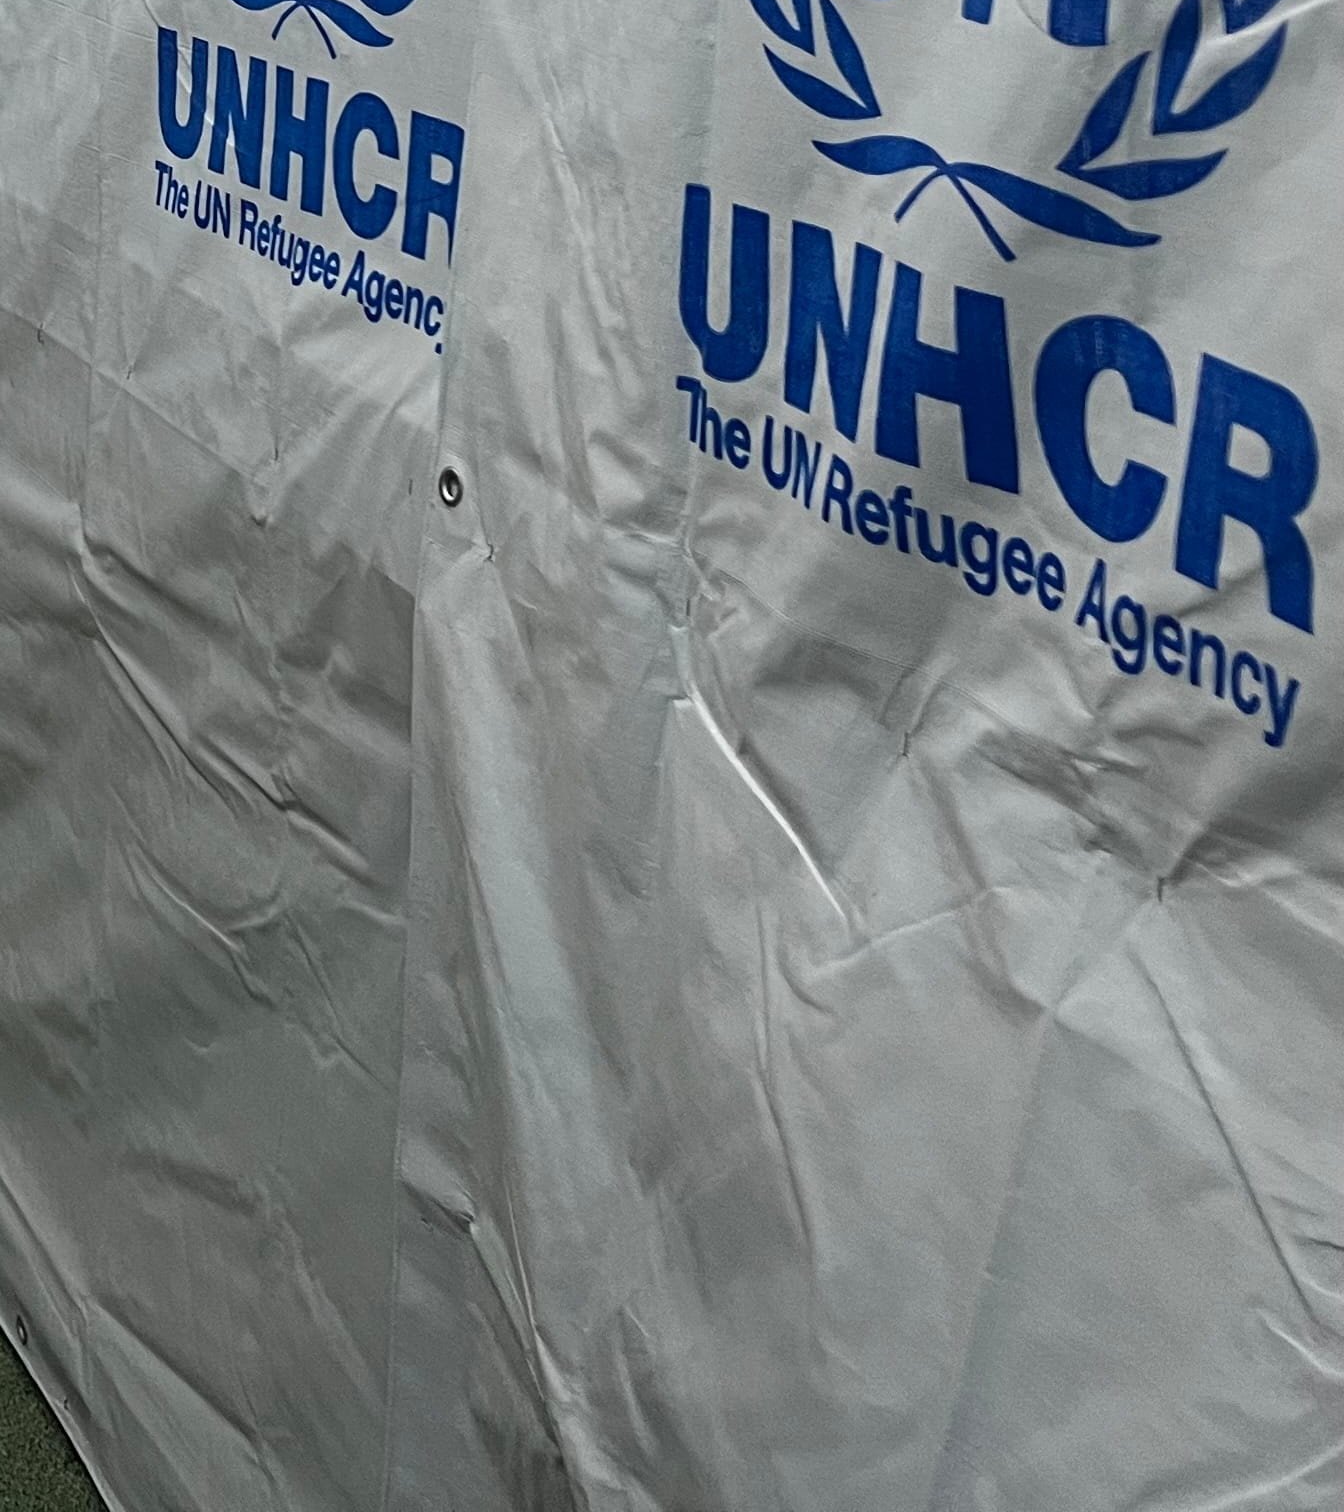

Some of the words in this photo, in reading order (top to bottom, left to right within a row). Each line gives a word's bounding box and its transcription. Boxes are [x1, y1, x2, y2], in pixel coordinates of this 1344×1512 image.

[155, 159, 190, 219] The
[193, 179, 231, 239] UN
[238, 198, 341, 290] Refugee
[341, 249, 444, 355] Agenc
[156, 25, 466, 268] UNHCR
[675, 374, 752, 470] The
[761, 414, 823, 510] UN
[820, 453, 1066, 613] Refugee
[1075, 558, 1301, 749] Agency
[678, 182, 1320, 636] UNHCR
